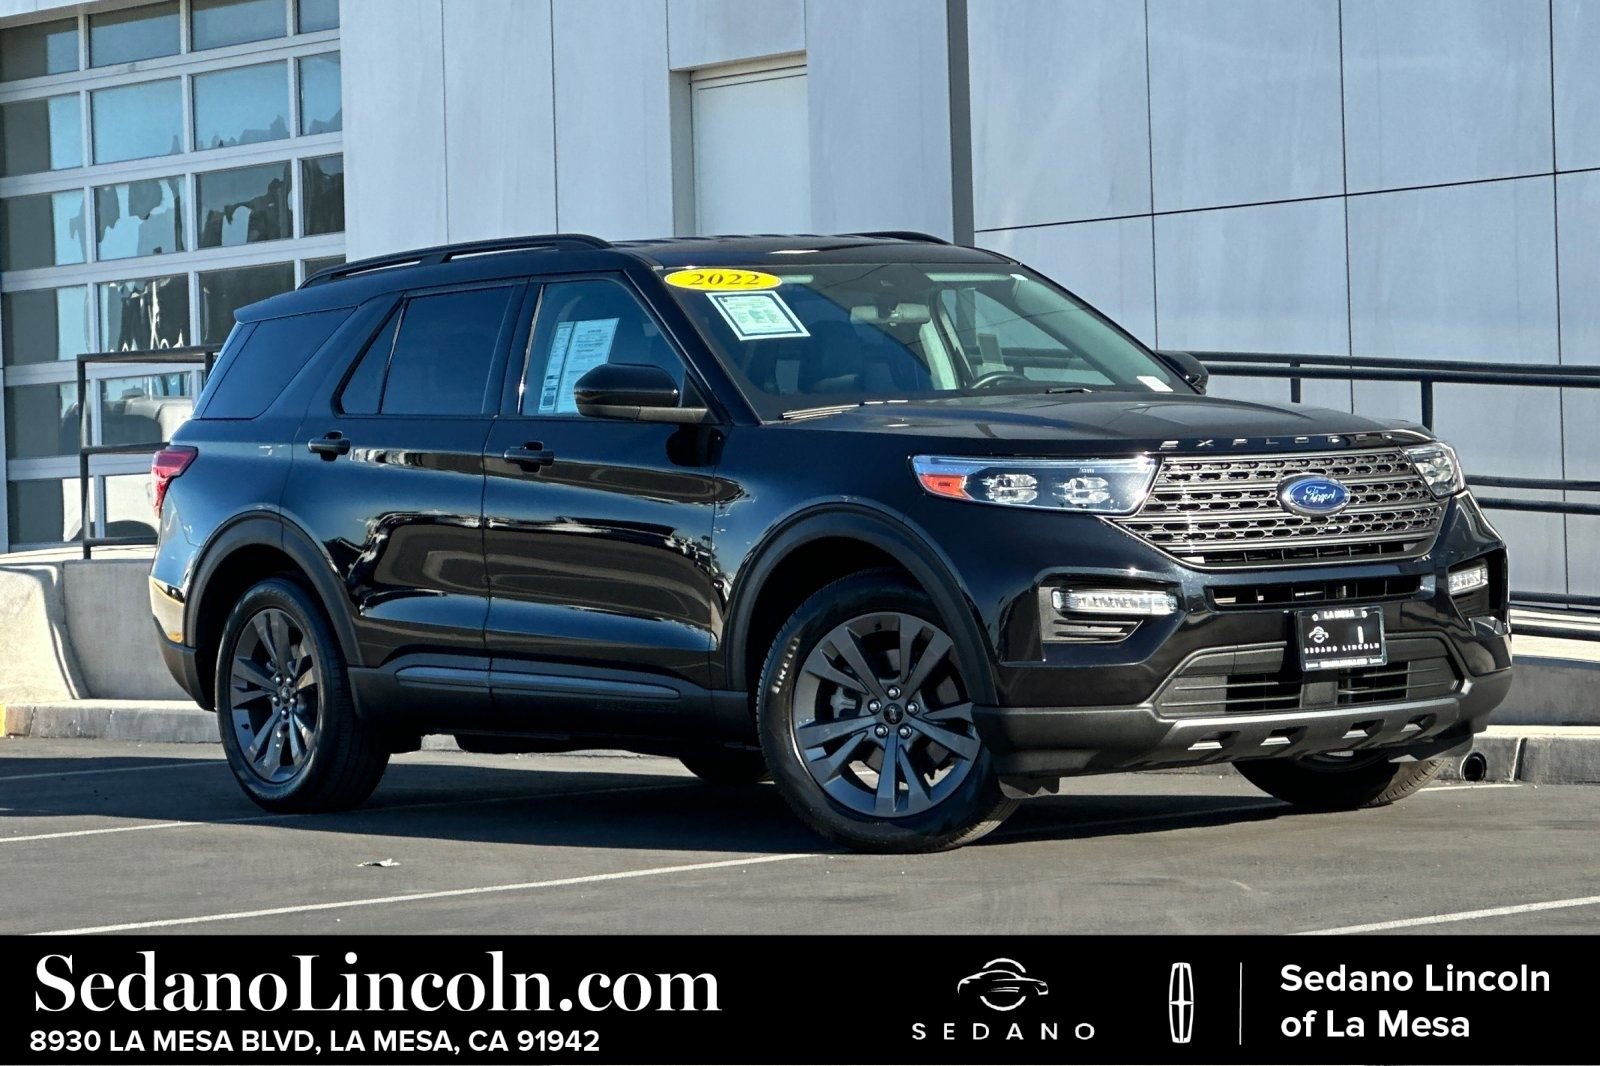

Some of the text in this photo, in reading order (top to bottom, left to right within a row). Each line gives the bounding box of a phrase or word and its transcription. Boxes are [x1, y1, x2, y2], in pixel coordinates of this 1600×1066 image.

[689, 273, 760, 286] 2022
[1303, 485, 1336, 502] Ford
[1304, 642, 1380, 654] SEDANO LINCOLN
